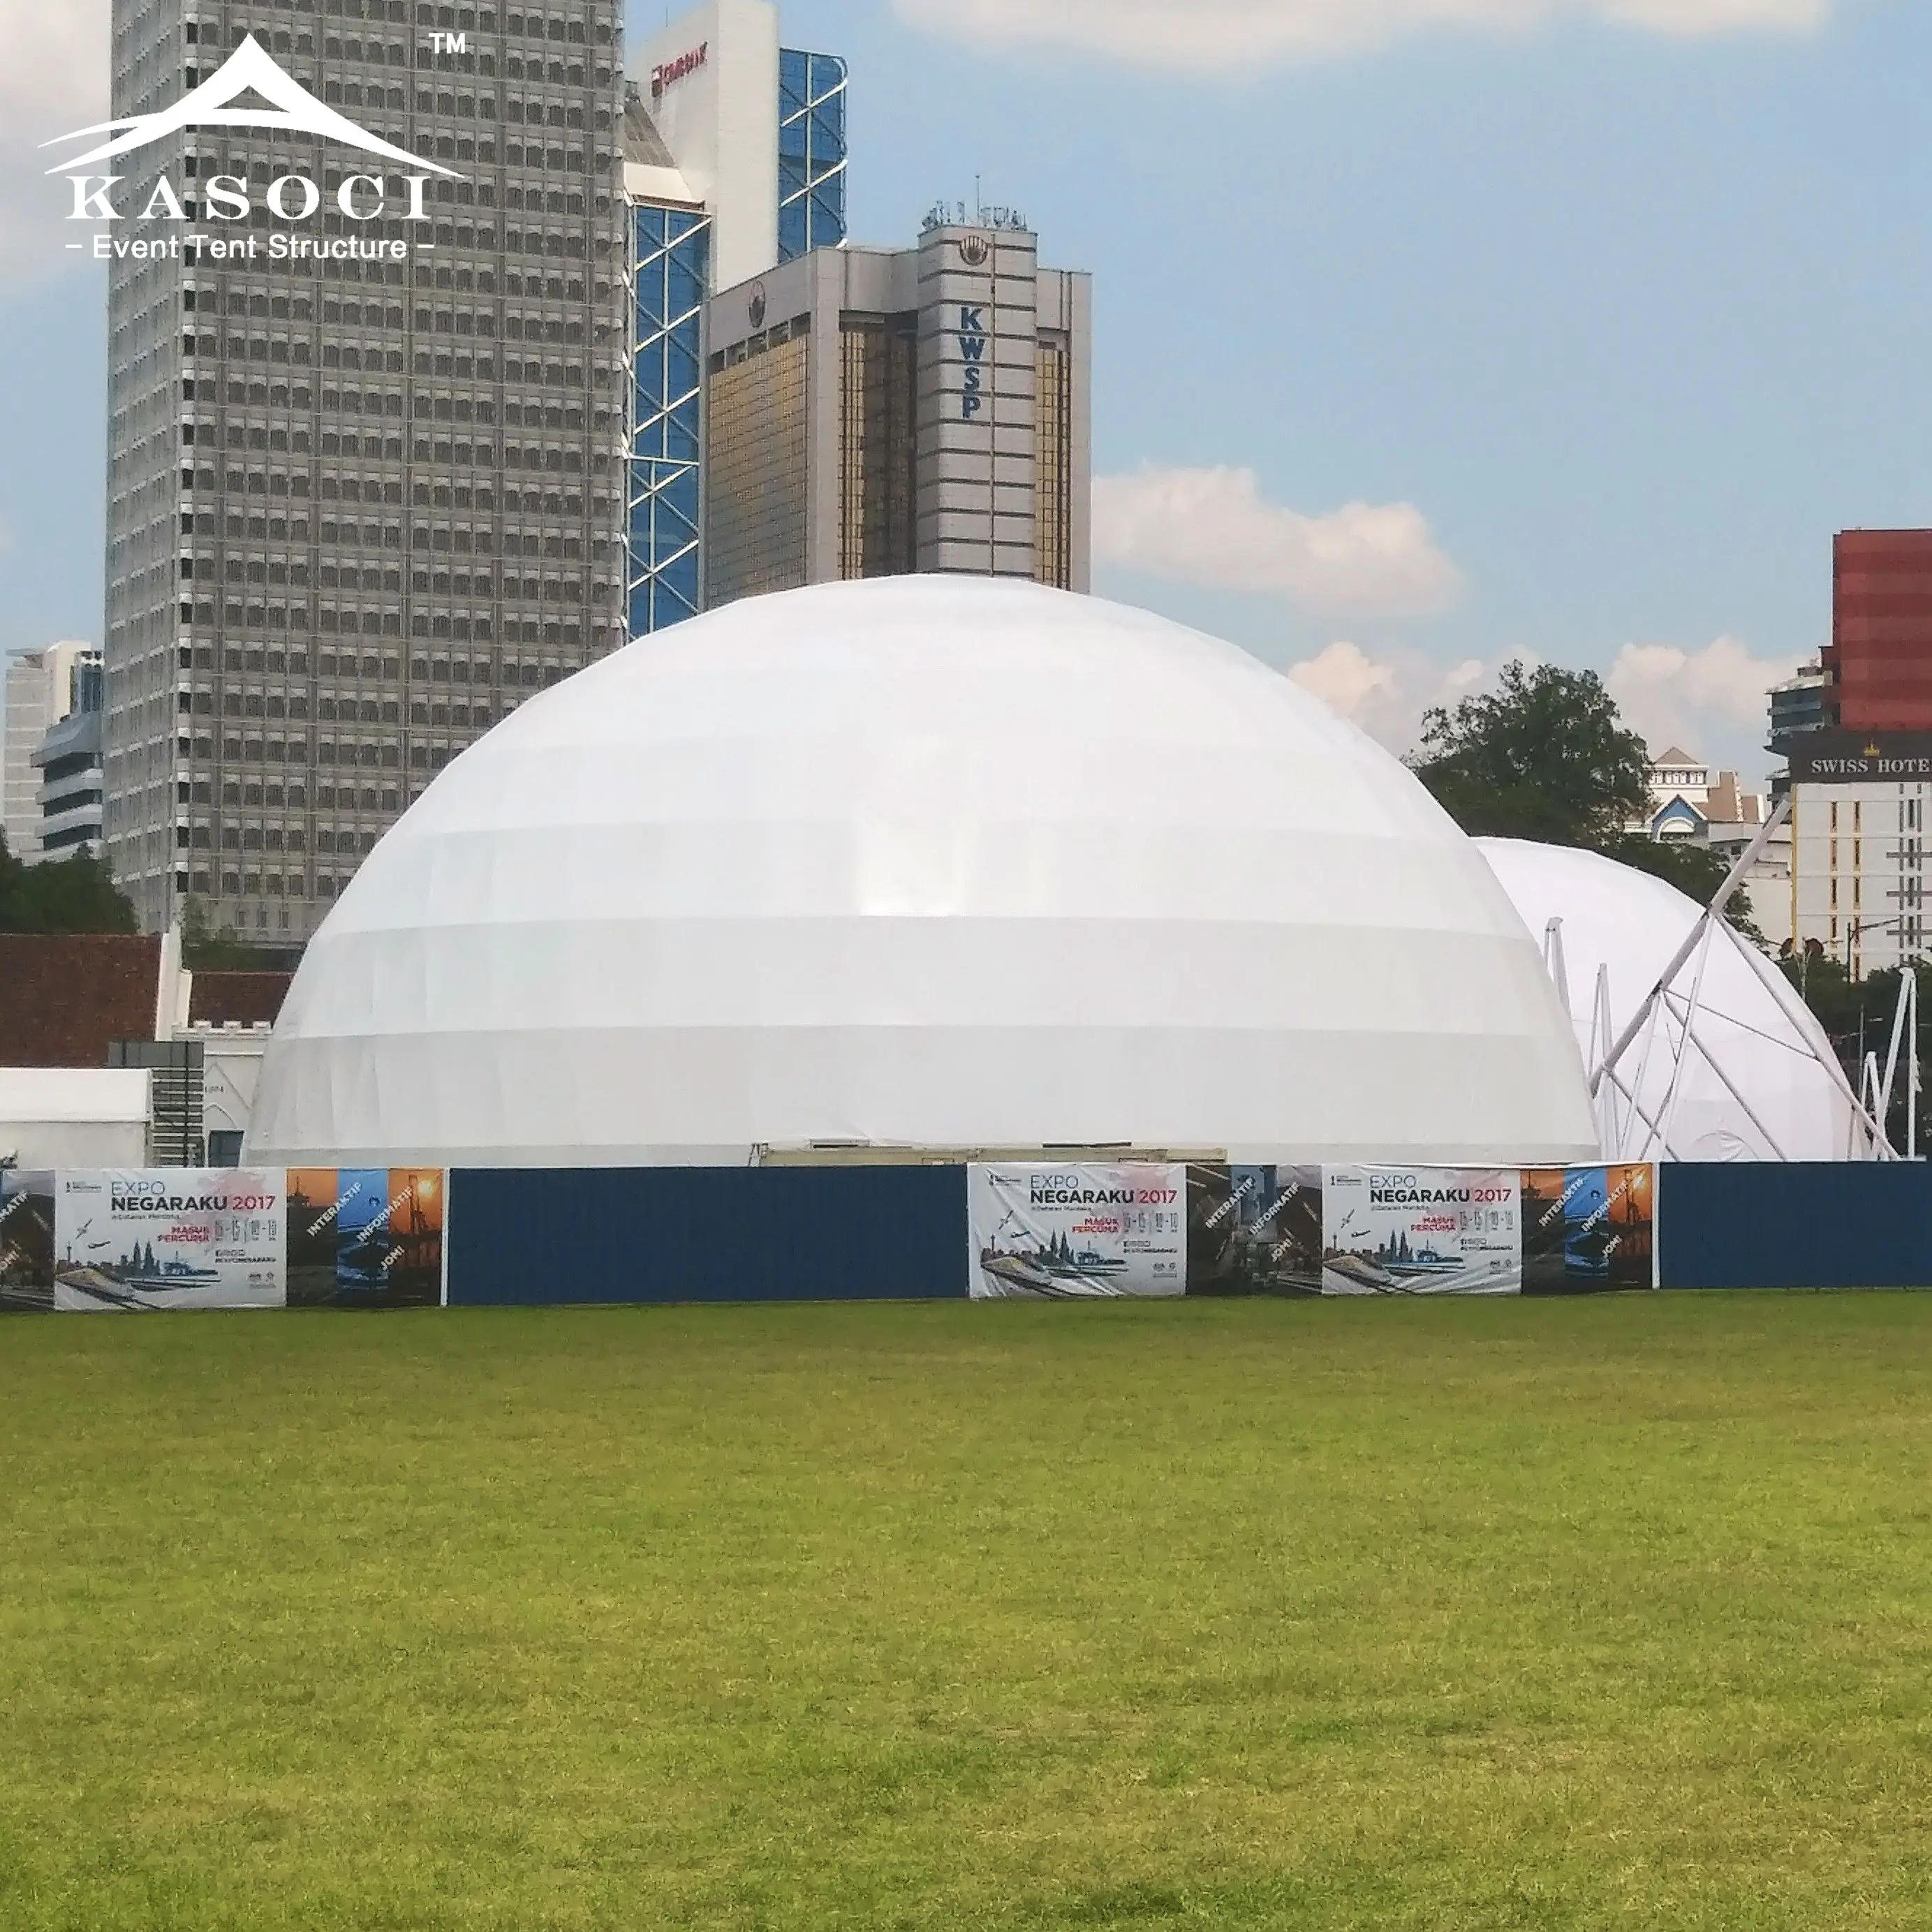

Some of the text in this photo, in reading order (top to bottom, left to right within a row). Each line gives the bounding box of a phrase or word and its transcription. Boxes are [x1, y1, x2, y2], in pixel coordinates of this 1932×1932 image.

[960, 307, 985, 418] KWSP
[1811, 758, 1932, 774] SWISS HOTE
[112, 1181, 165, 1196] EXPO
[1031, 1175, 1079, 1188] EXPO
[1370, 1175, 1417, 1188] EXPO
[111, 1195, 276, 1211] NEGARAKU 2017
[1031, 1189, 1178, 1204] NEGARAKU 2017
[1204, 1177, 1255, 1229] INTERAKTIF
[1370, 1189, 1512, 1202] NEGARAKU 2017
[307, 1181, 362, 1237] INTERAKTIF
[356, 1186, 413, 1242] INFORMATIF
[1248, 1181, 1300, 1235] INFORMATIF
